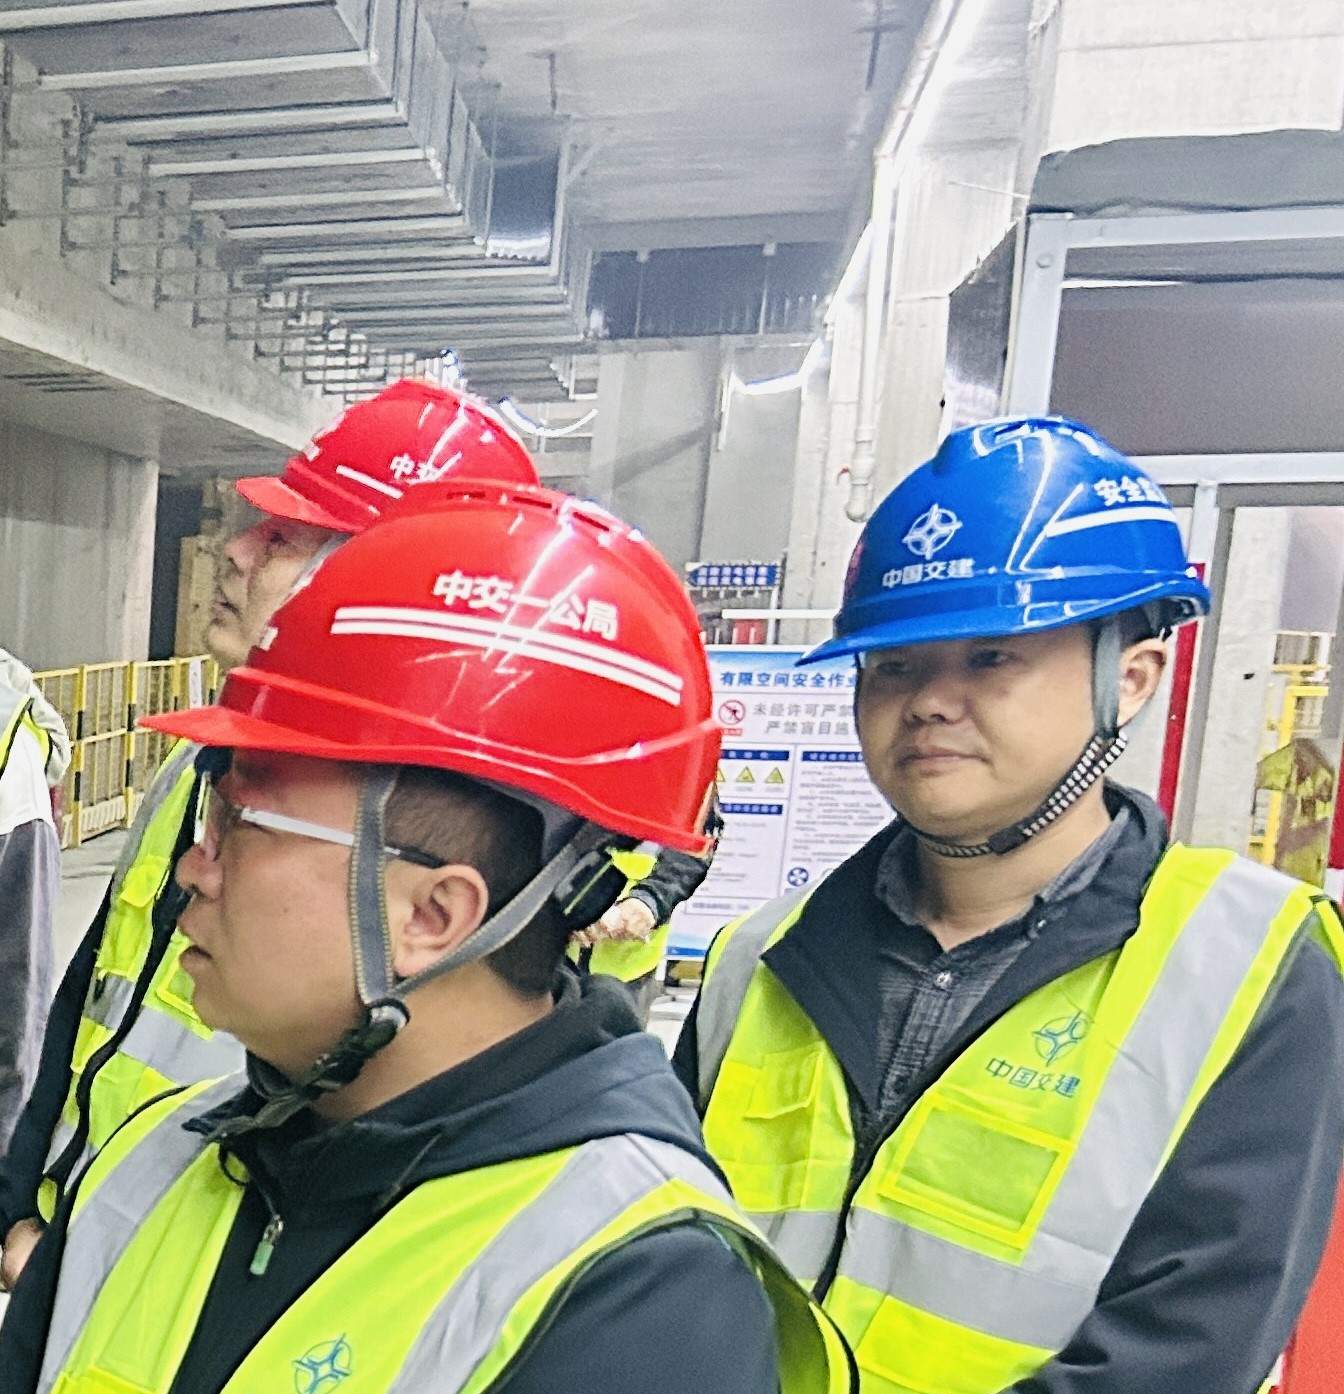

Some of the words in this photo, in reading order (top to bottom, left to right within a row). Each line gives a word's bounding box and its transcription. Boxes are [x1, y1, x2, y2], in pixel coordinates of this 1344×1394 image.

[882, 558, 975, 589] 中国交建
[433, 569, 618, 640] 中交一公局
[985, 1056, 1081, 1099] 中国交建
